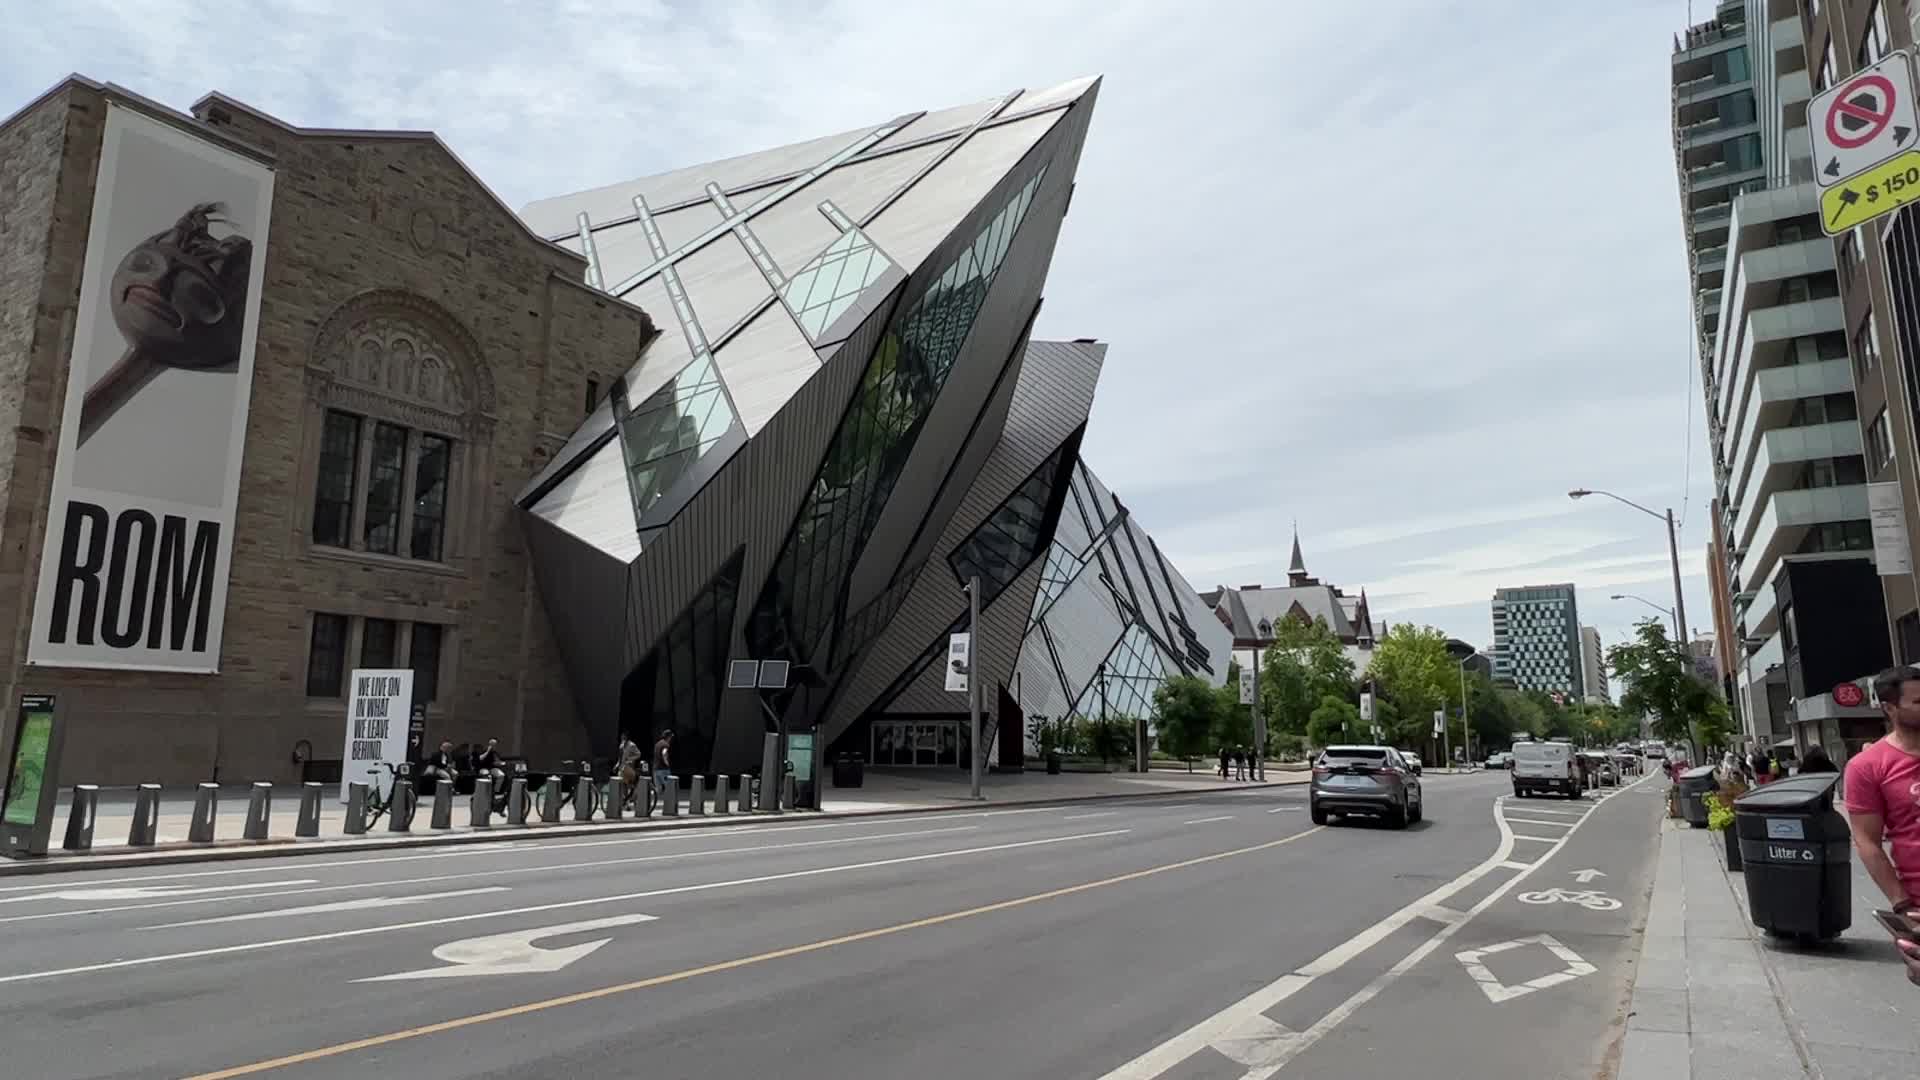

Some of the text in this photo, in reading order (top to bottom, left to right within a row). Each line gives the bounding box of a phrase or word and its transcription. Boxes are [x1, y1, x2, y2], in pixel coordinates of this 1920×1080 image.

[1882, 167, 1919, 194] 150
[48, 500, 221, 652] ROM
[358, 677, 400, 696] WE LIVE ON
[356, 698, 389, 717] IN WHAT
[354, 719, 389, 738] WE LEAVE
[352, 740, 383, 760] BEHIND.
[1769, 845, 1796, 859] Litter
